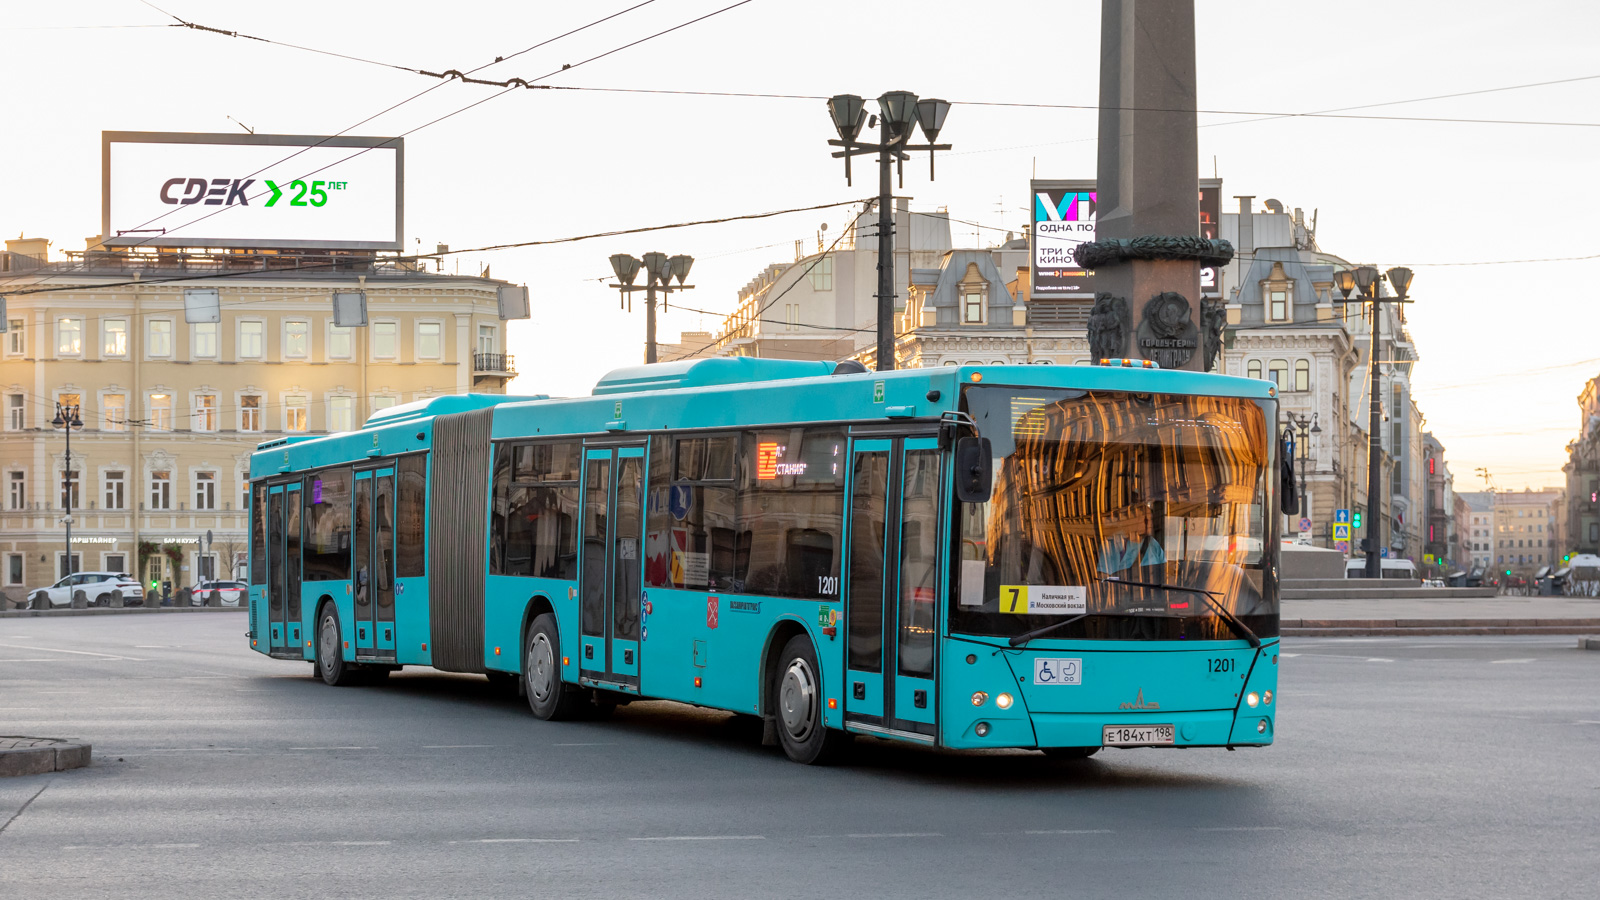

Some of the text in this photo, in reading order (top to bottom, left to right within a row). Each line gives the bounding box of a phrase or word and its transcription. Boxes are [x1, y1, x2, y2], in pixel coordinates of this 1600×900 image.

[289, 180, 348, 207] 25 ЛЕТ
[1040, 224, 1096, 233] ОДНА ПО
[1040, 248, 1063, 256] ТРИ
[1040, 256, 1077, 264] КИНО
[818, 576, 838, 595] 1201
[1008, 588, 1020, 612] 7
[1207, 658, 1235, 672] 1201
[1155, 727, 1170, 737] 198
